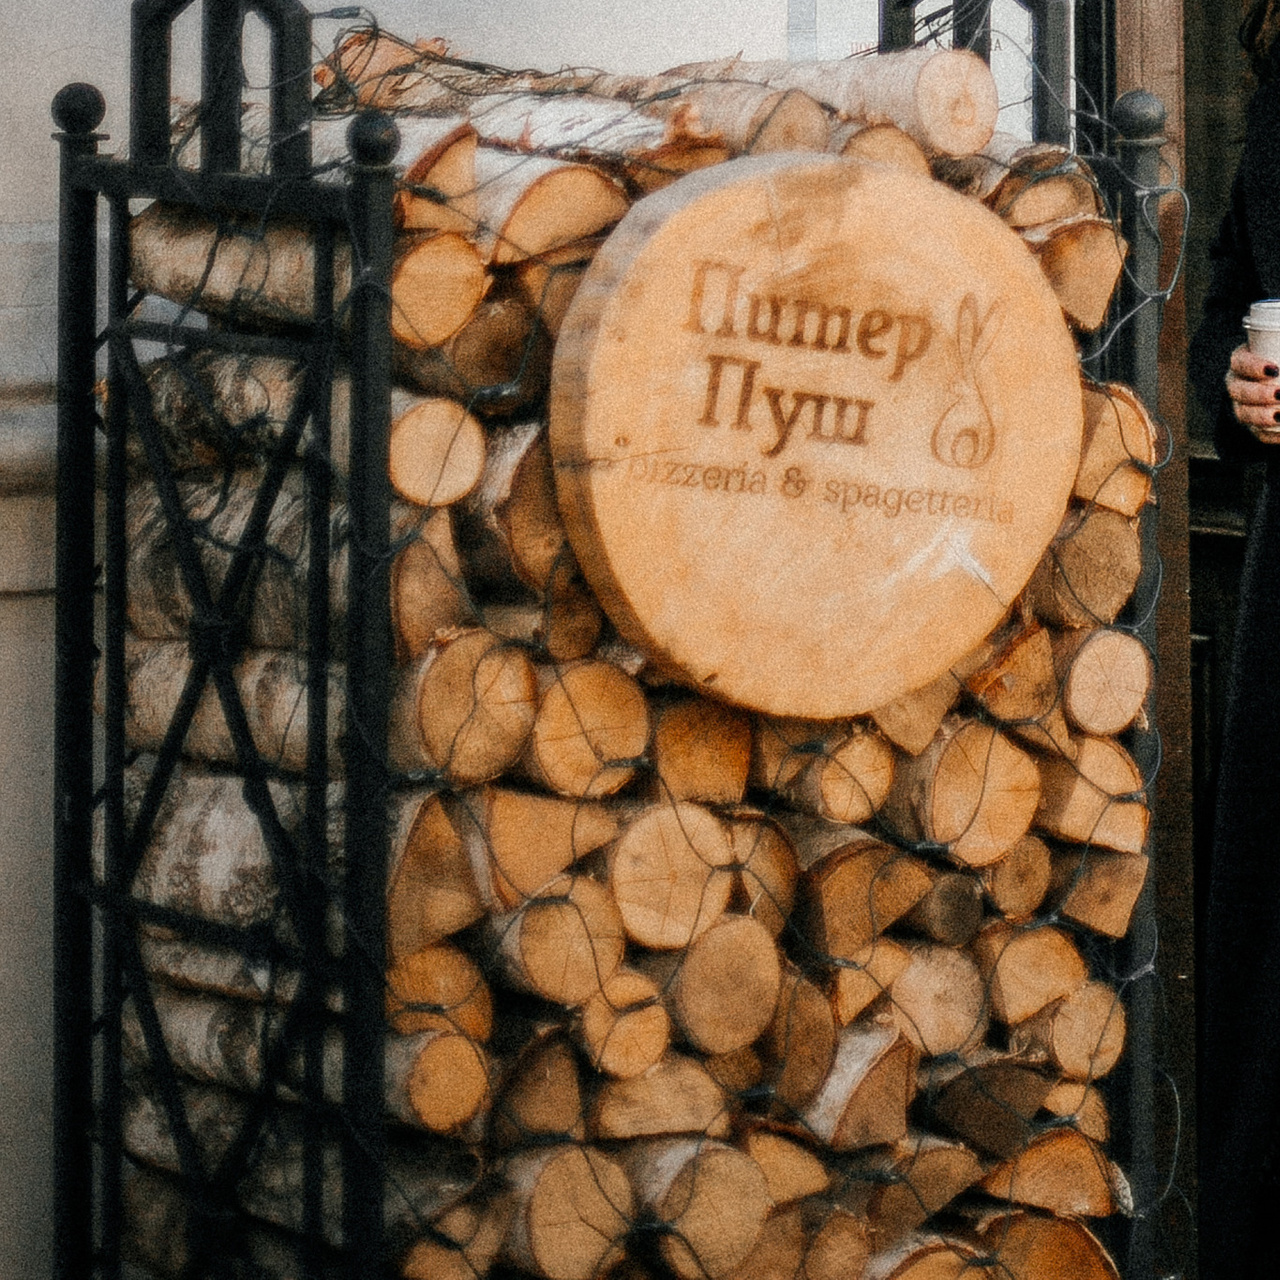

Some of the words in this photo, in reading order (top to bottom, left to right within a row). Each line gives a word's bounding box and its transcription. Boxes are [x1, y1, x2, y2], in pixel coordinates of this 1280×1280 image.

[681, 257, 938, 384] Питер
[696, 352, 877, 459] Пуш
[626, 455, 768, 496] pizzeria
[779, 465, 808, 499] &
[822, 476, 1016, 526] spagetteria
